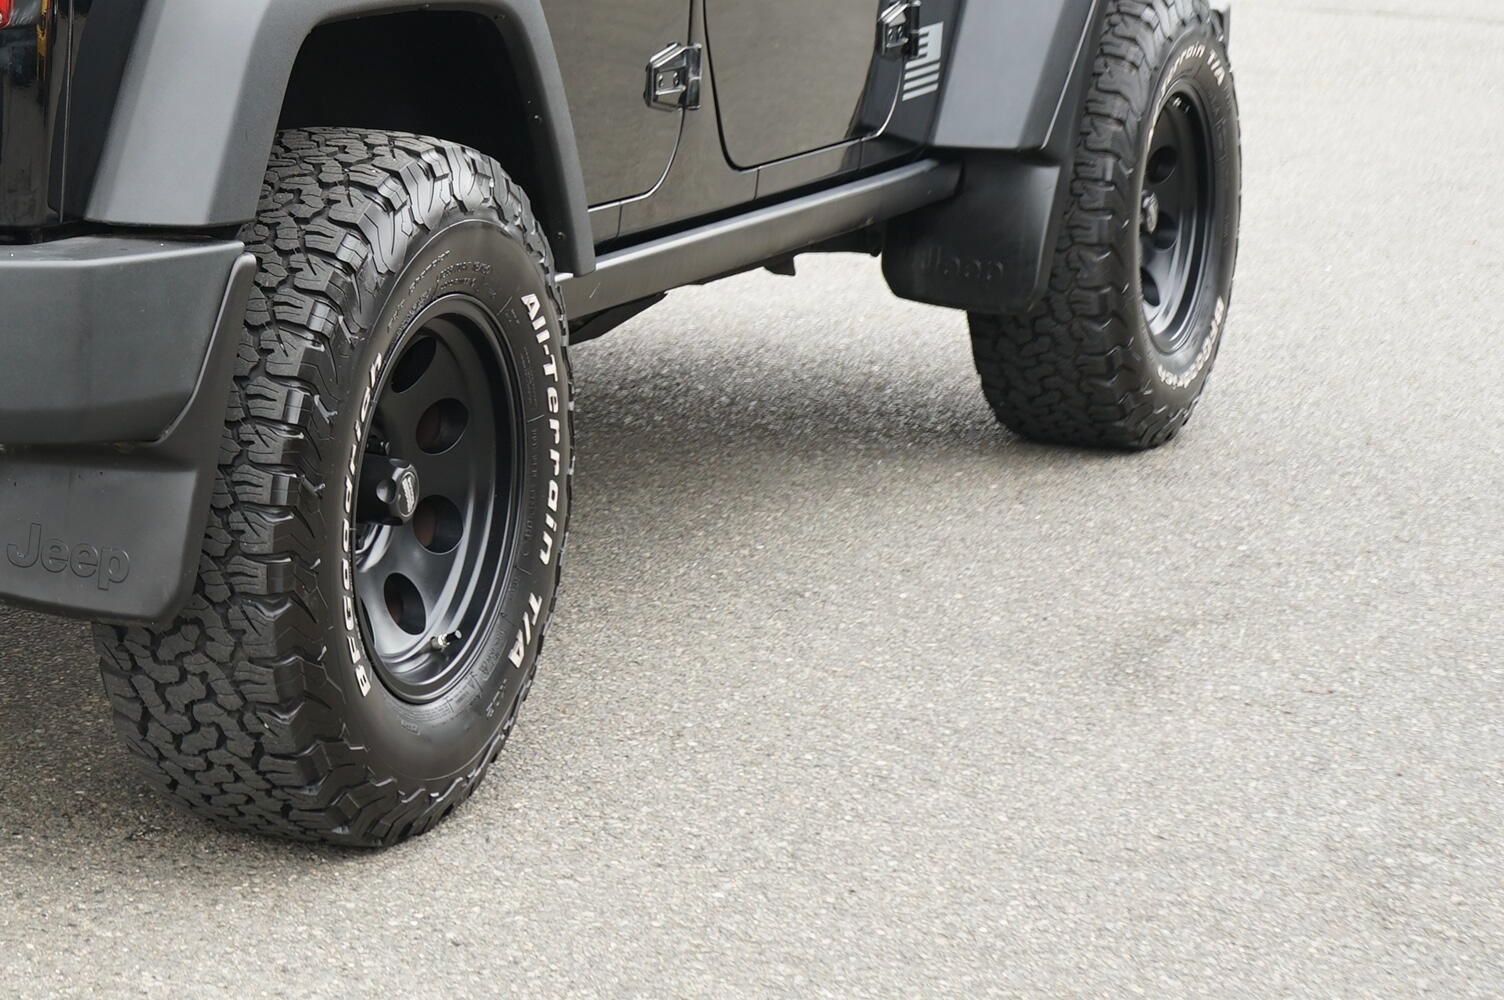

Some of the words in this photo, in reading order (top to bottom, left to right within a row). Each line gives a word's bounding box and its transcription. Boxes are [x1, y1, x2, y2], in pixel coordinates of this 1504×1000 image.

[520, 292, 560, 566] All-Terrain
[6, 522, 130, 591] Jeep
[342, 352, 383, 696] BFGoodrich
[508, 592, 543, 669] T/A
